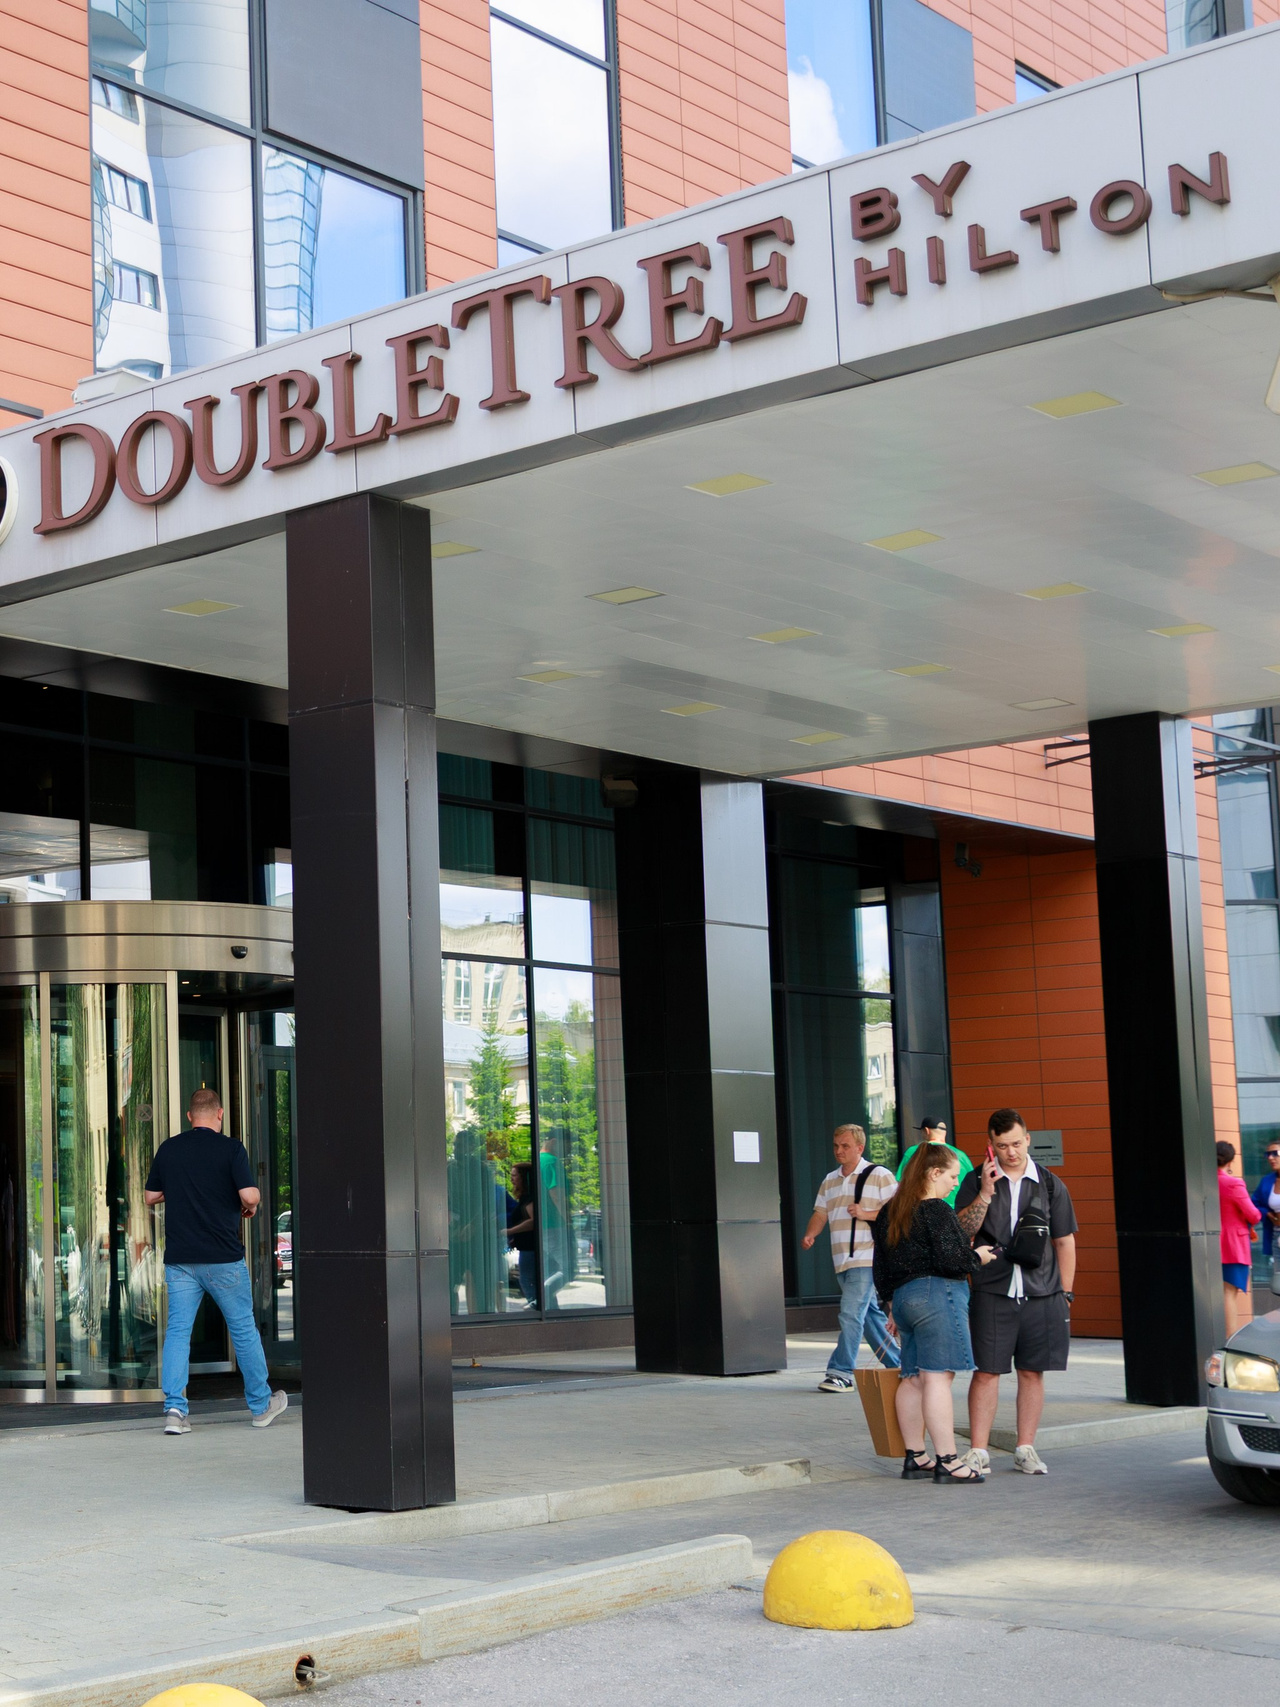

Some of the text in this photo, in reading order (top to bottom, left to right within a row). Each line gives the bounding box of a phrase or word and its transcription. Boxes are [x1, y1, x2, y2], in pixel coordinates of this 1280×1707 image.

[850, 160, 972, 242] BY
[854, 151, 1232, 306] HILTON
[33, 216, 807, 536] DOUBLETREE
